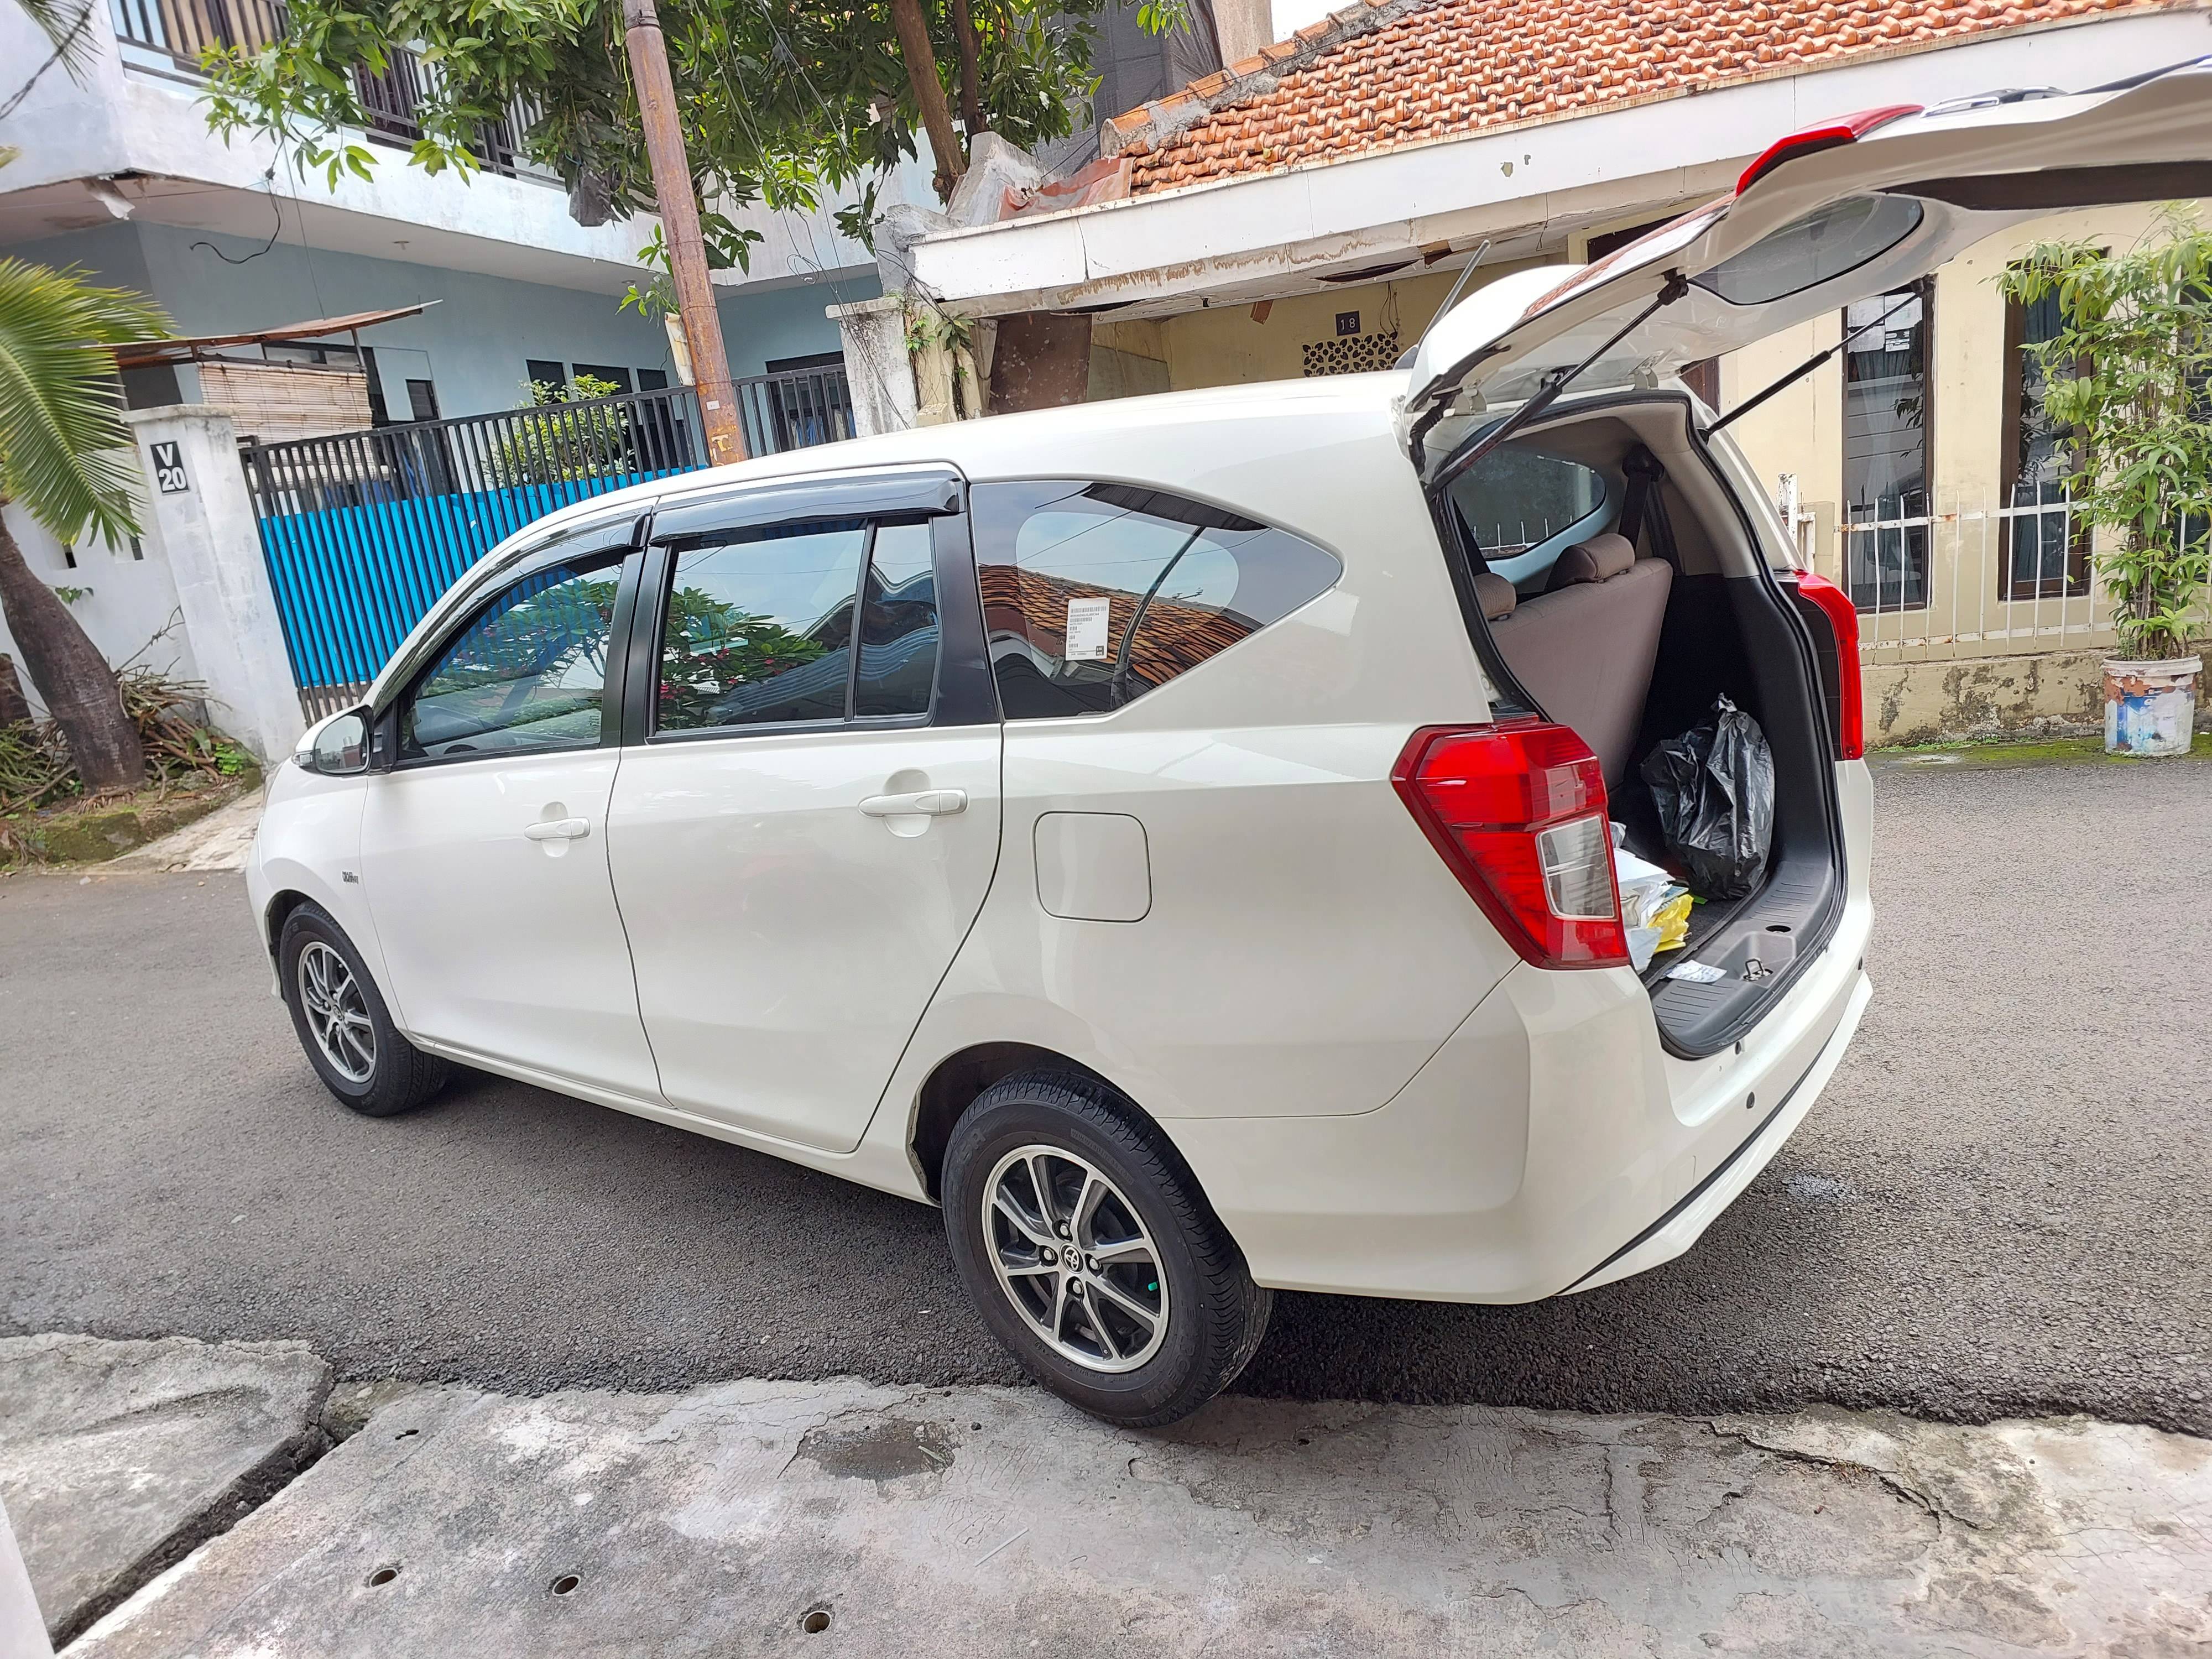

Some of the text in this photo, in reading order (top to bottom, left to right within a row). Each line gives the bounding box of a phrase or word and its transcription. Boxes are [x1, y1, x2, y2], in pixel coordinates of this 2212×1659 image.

[1341, 318, 1355, 331] 18
[156, 444, 173, 466] V
[159, 467, 186, 491] 20
